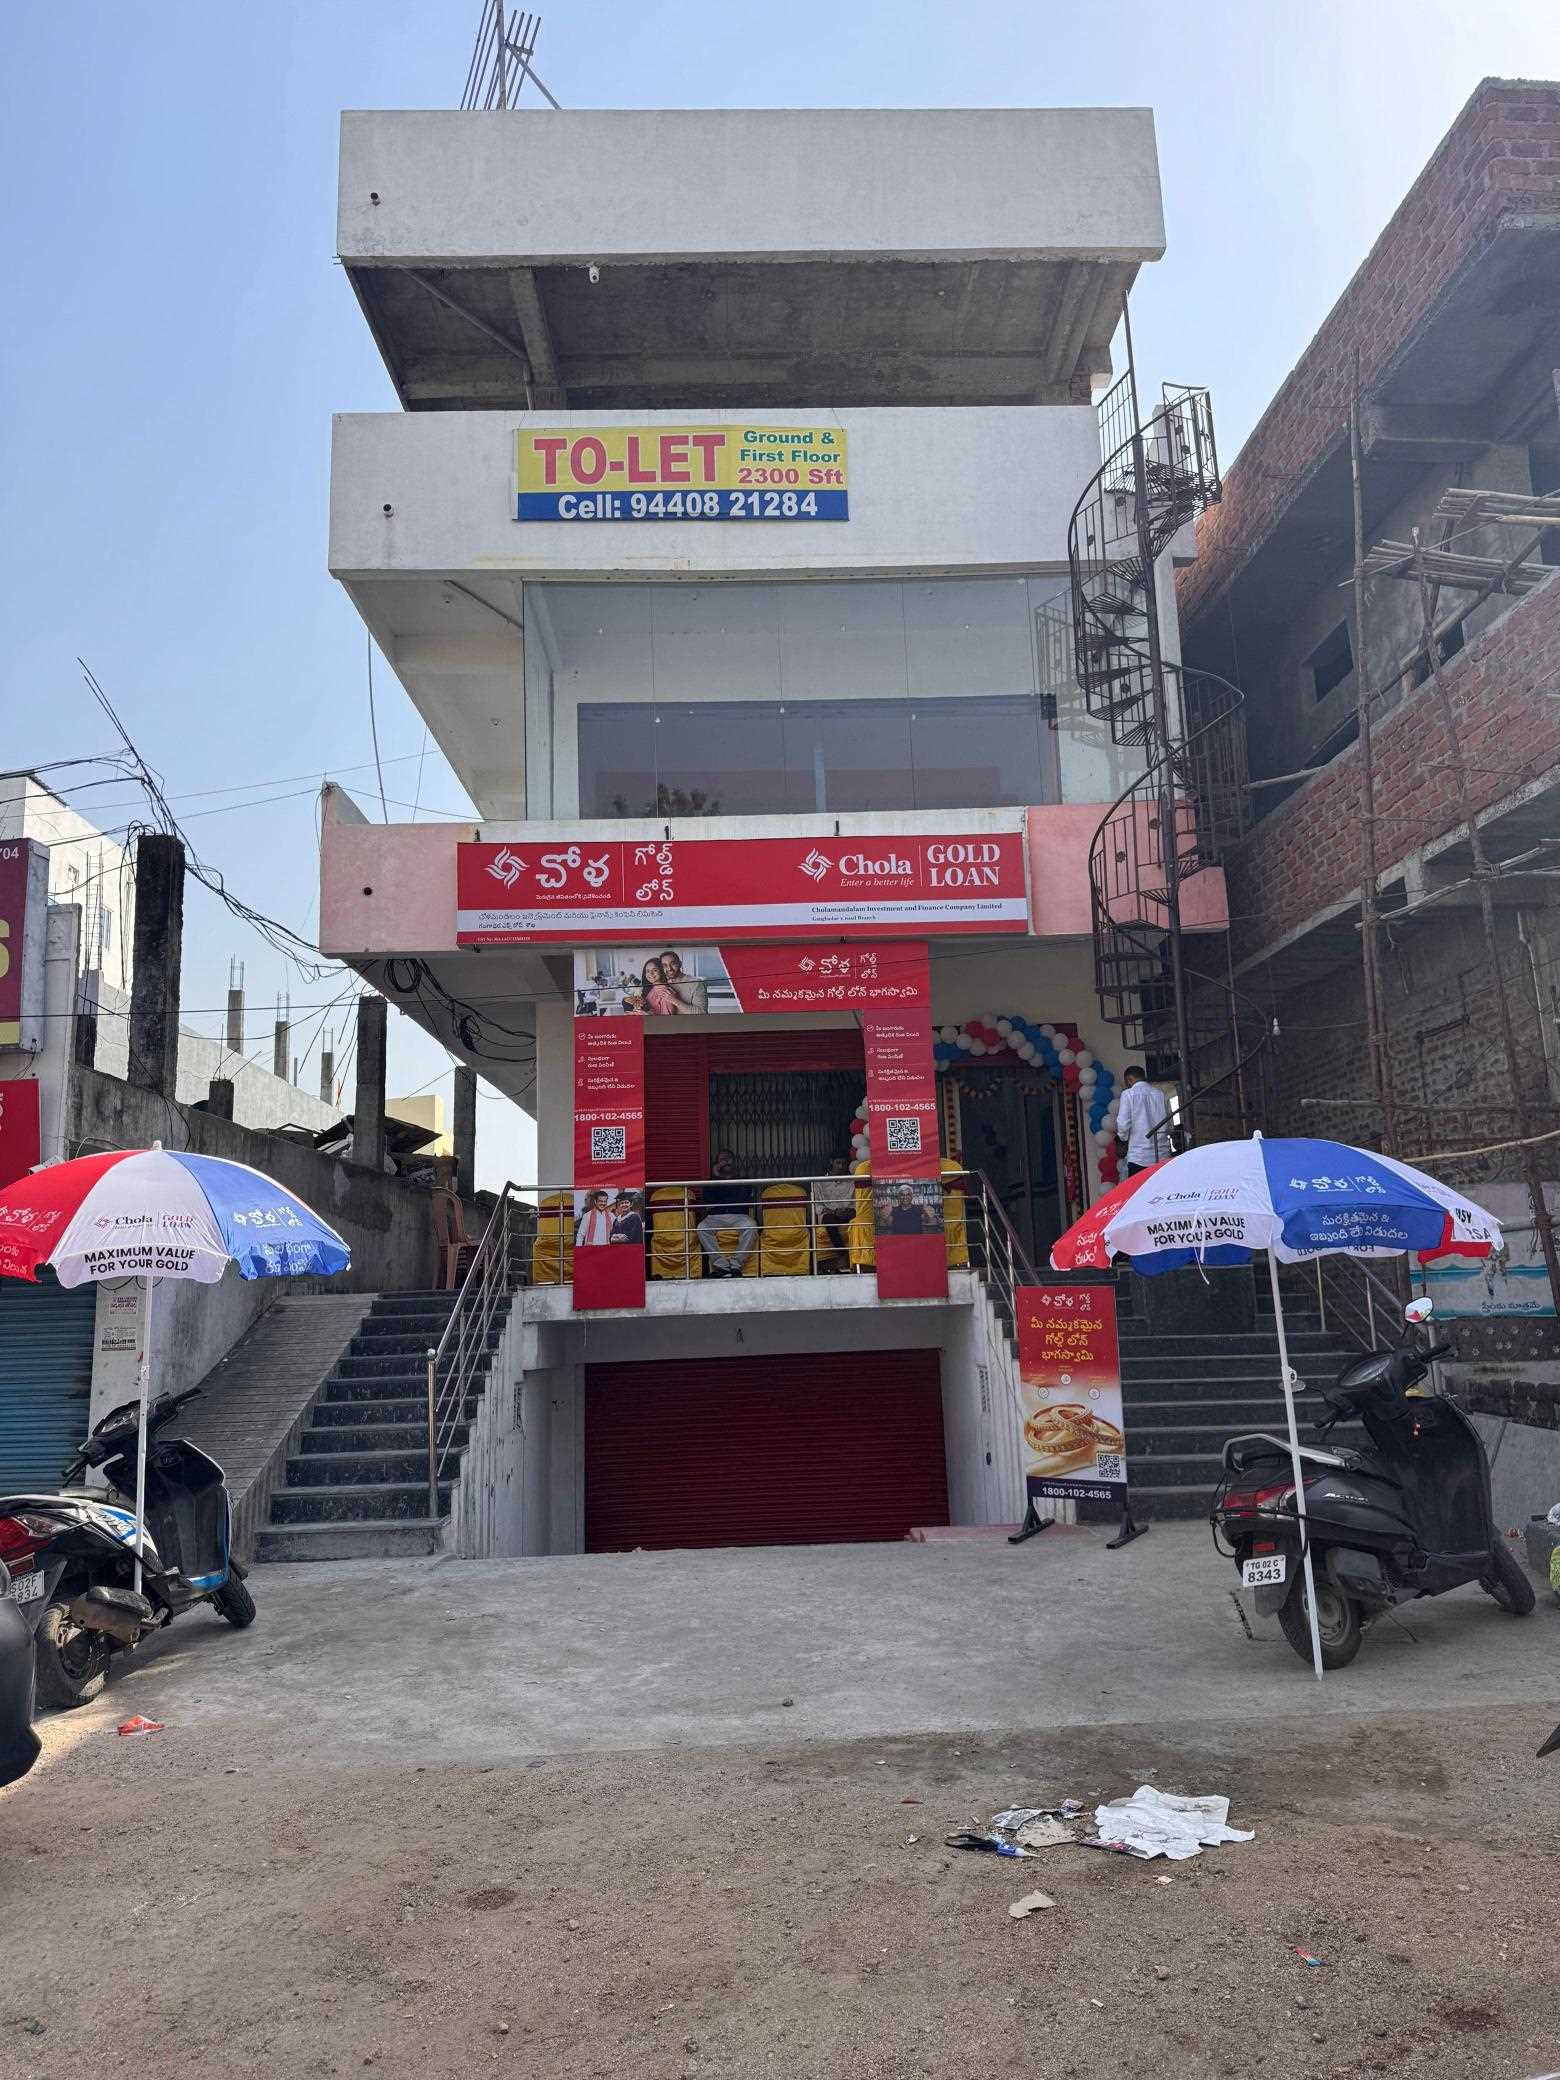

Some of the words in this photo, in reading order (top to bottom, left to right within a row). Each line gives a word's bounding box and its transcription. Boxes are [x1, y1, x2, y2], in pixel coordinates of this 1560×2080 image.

[743, 430, 813, 445] Ground
[821, 431, 835, 444] &
[534, 433, 726, 485] TO-LET
[740, 449, 785, 463] First
[791, 450, 840, 463] Floor
[737, 468, 799, 485] 2300
[808, 468, 844, 485] Sft
[558, 495, 621, 519] Cell:
[630, 493, 719, 517] 94408
[729, 491, 818, 516] 21284
[634, 843, 673, 876] గోల్డ్
[927, 844, 1001, 864] GOLD
[535, 846, 610, 888] చోళ
[838, 853, 913, 875] Chola
[840, 878, 864, 887] Enter
[873, 878, 899, 887] better
[900, 877, 914, 888] life
[928, 866, 1001, 887] LOAN
[635, 879, 674, 901] లోన్
[811, 905, 866, 913] Cholamandalam
[867, 904, 903, 912] Investment
[904, 903, 917, 911] and
[918, 903, 945, 911] Finance
[946, 903, 976, 912] Company
[977, 902, 1002, 910] Limited
[819, 955, 850, 975] చోళ
[860, 953, 878, 969] గోల్డ్
[860, 969, 878, 979] లోన్
[758, 988, 769, 1000] మీ
[772, 987, 825, 1001] నమ్మకమైన
[826, 986, 845, 1000] గోల్డ్
[848, 986, 867, 998] లోన్
[869, 986, 918, 1000] భాగస్వామి
[869, 1103, 936, 1112] 1800-102-4565
[574, 1112, 643, 1122] 1800-102-4565
[1312, 1176, 1348, 1189] చోళ
[1167, 1191, 1201, 1201] Chola
[1210, 1187, 1239, 1195] GOLD
[115, 1215, 153, 1225] Chola
[163, 1215, 194, 1223] GOLD
[163, 1221, 192, 1229] LOAN
[1211, 1216, 1246, 1229] VALUE
[1322, 1211, 1379, 1226] సురక్షితమైన
[1154, 1232, 1176, 1246] FOR
[1178, 1230, 1212, 1243] YOUR
[1214, 1228, 1244, 1240] GOLD
[84, 1246, 153, 1264] MAXIMUM
[156, 1247, 196, 1259] VALUE
[90, 1261, 116, 1275] FOR
[119, 1259, 153, 1269] YOUR
[156, 1260, 189, 1272] GOLD
[1053, 1293, 1074, 1307] చోళ
[1031, 1316, 1043, 1329] మీ
[1046, 1318, 1103, 1332] నమ్మకమైన
[1045, 1332, 1064, 1347] గోల్డ్
[1067, 1333, 1089, 1346] లోన్
[1041, 1350, 1094, 1362] భాగస్వామి
[1042, 1486, 1112, 1499] 1800-102-4565
[1250, 1561, 1261, 1570] TG
[1262, 1560, 1272, 1568] 02
[1247, 1568, 1281, 1583] 8343
